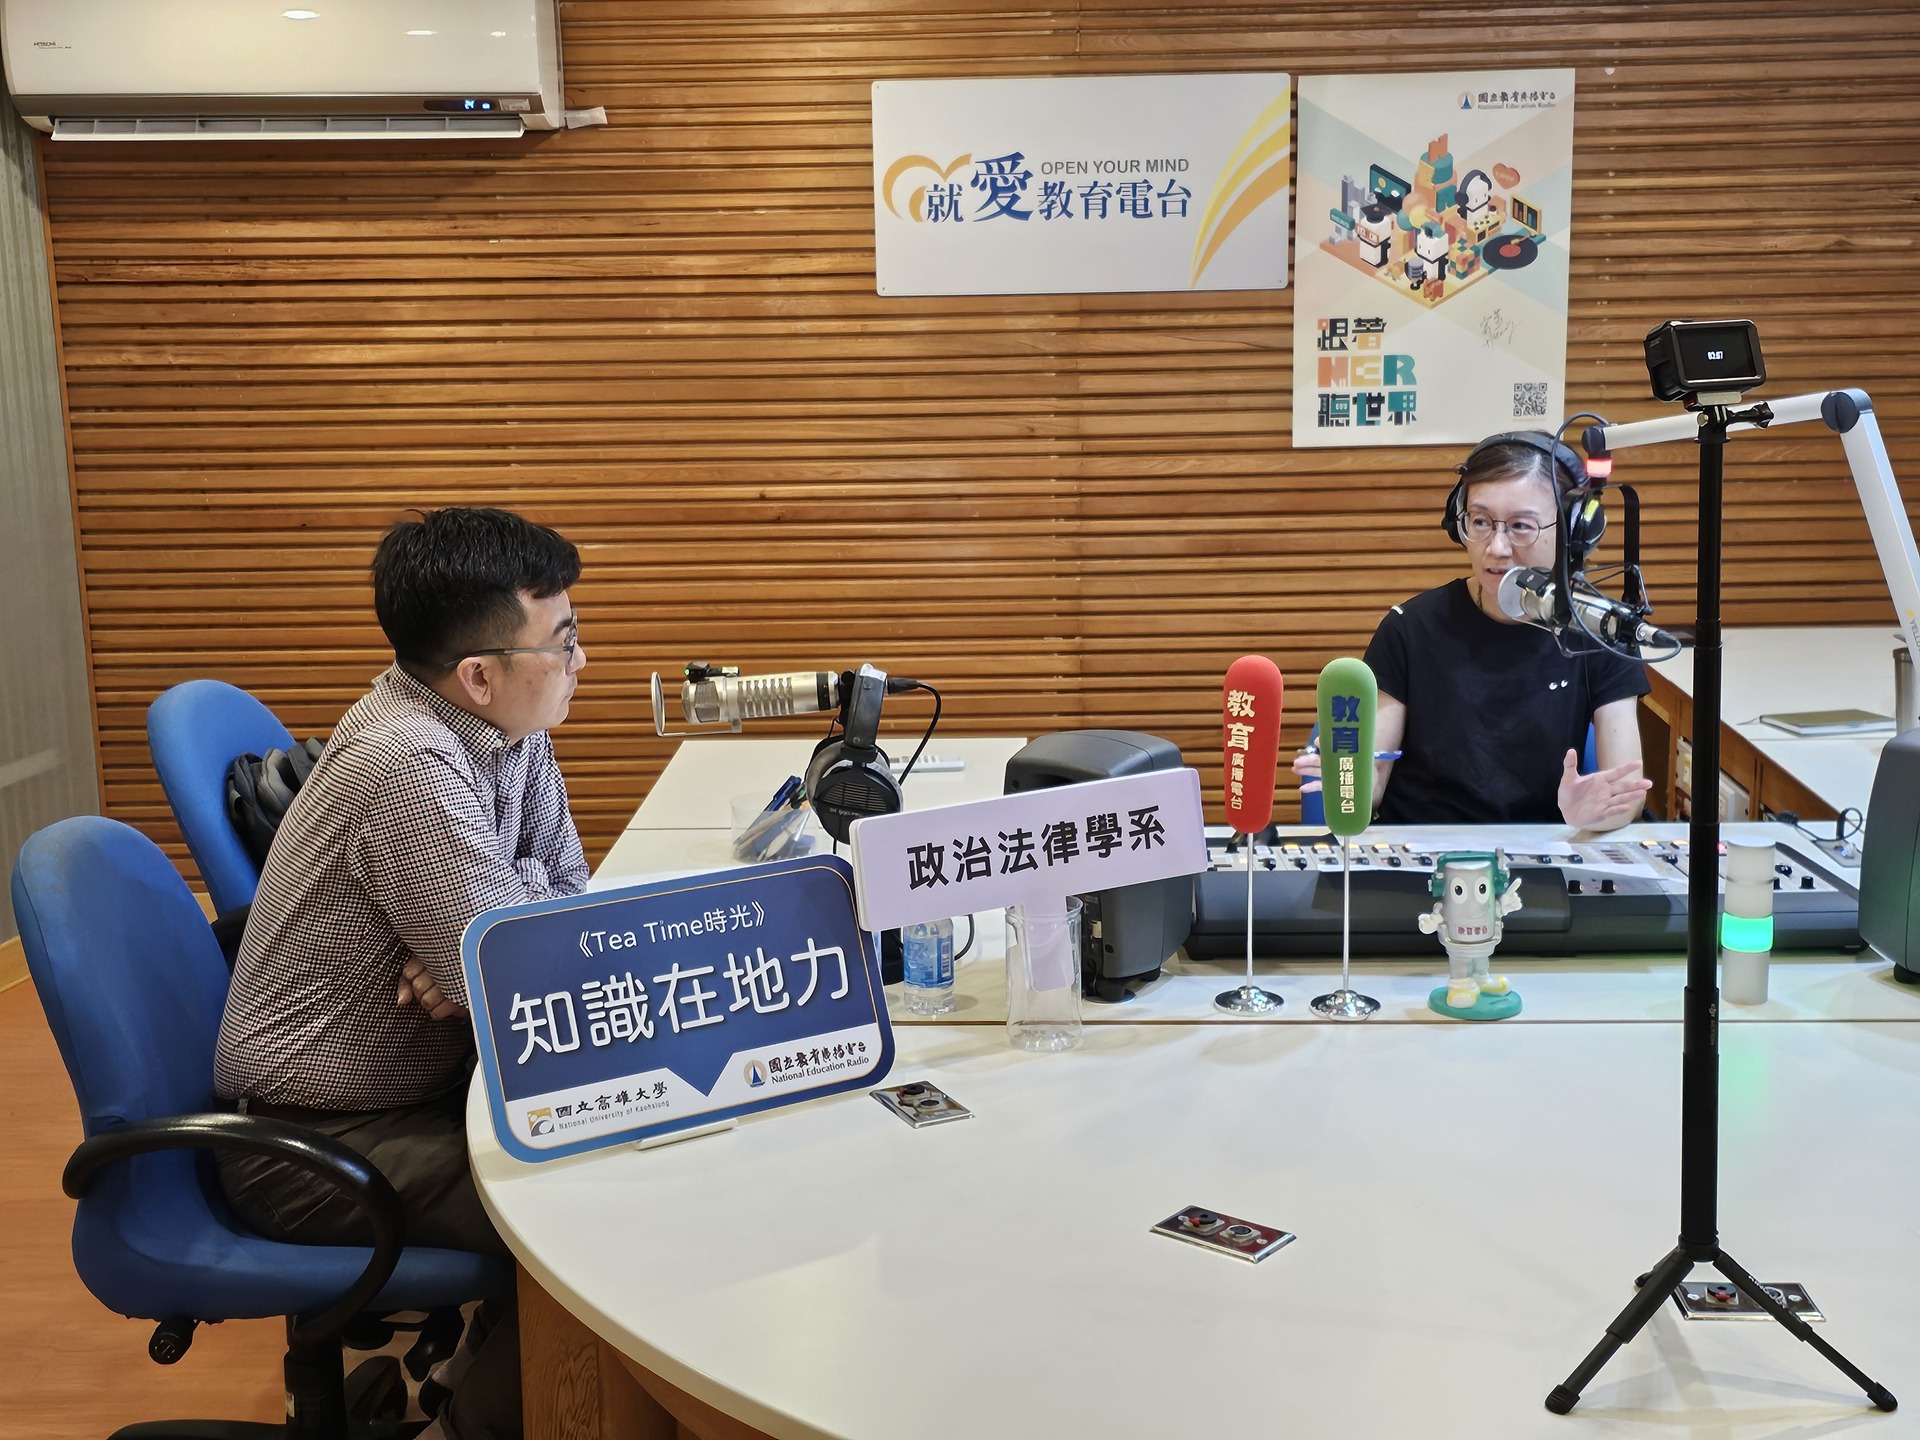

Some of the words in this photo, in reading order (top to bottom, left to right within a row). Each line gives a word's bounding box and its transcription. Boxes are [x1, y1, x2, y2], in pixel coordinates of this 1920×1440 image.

[1041, 161, 1088, 175] OPEN
[1093, 160, 1140, 174] YOUR
[1146, 158, 1190, 173] MIND
[926, 151, 1192, 223] 就愛教育電台
[1910, 619, 1920, 651] YELLO
[906, 805, 1166, 890] 政治法律學系
[508, 937, 850, 1065] 知識在地力
[771, 1068, 805, 1084] National
[806, 1061, 846, 1077] Education
[847, 1056, 870, 1068] Radio
[555, 1081, 668, 1118] 國立高雄大學
[559, 1116, 588, 1130] National
[590, 1111, 623, 1122] University
[626, 1107, 633, 1115] of
